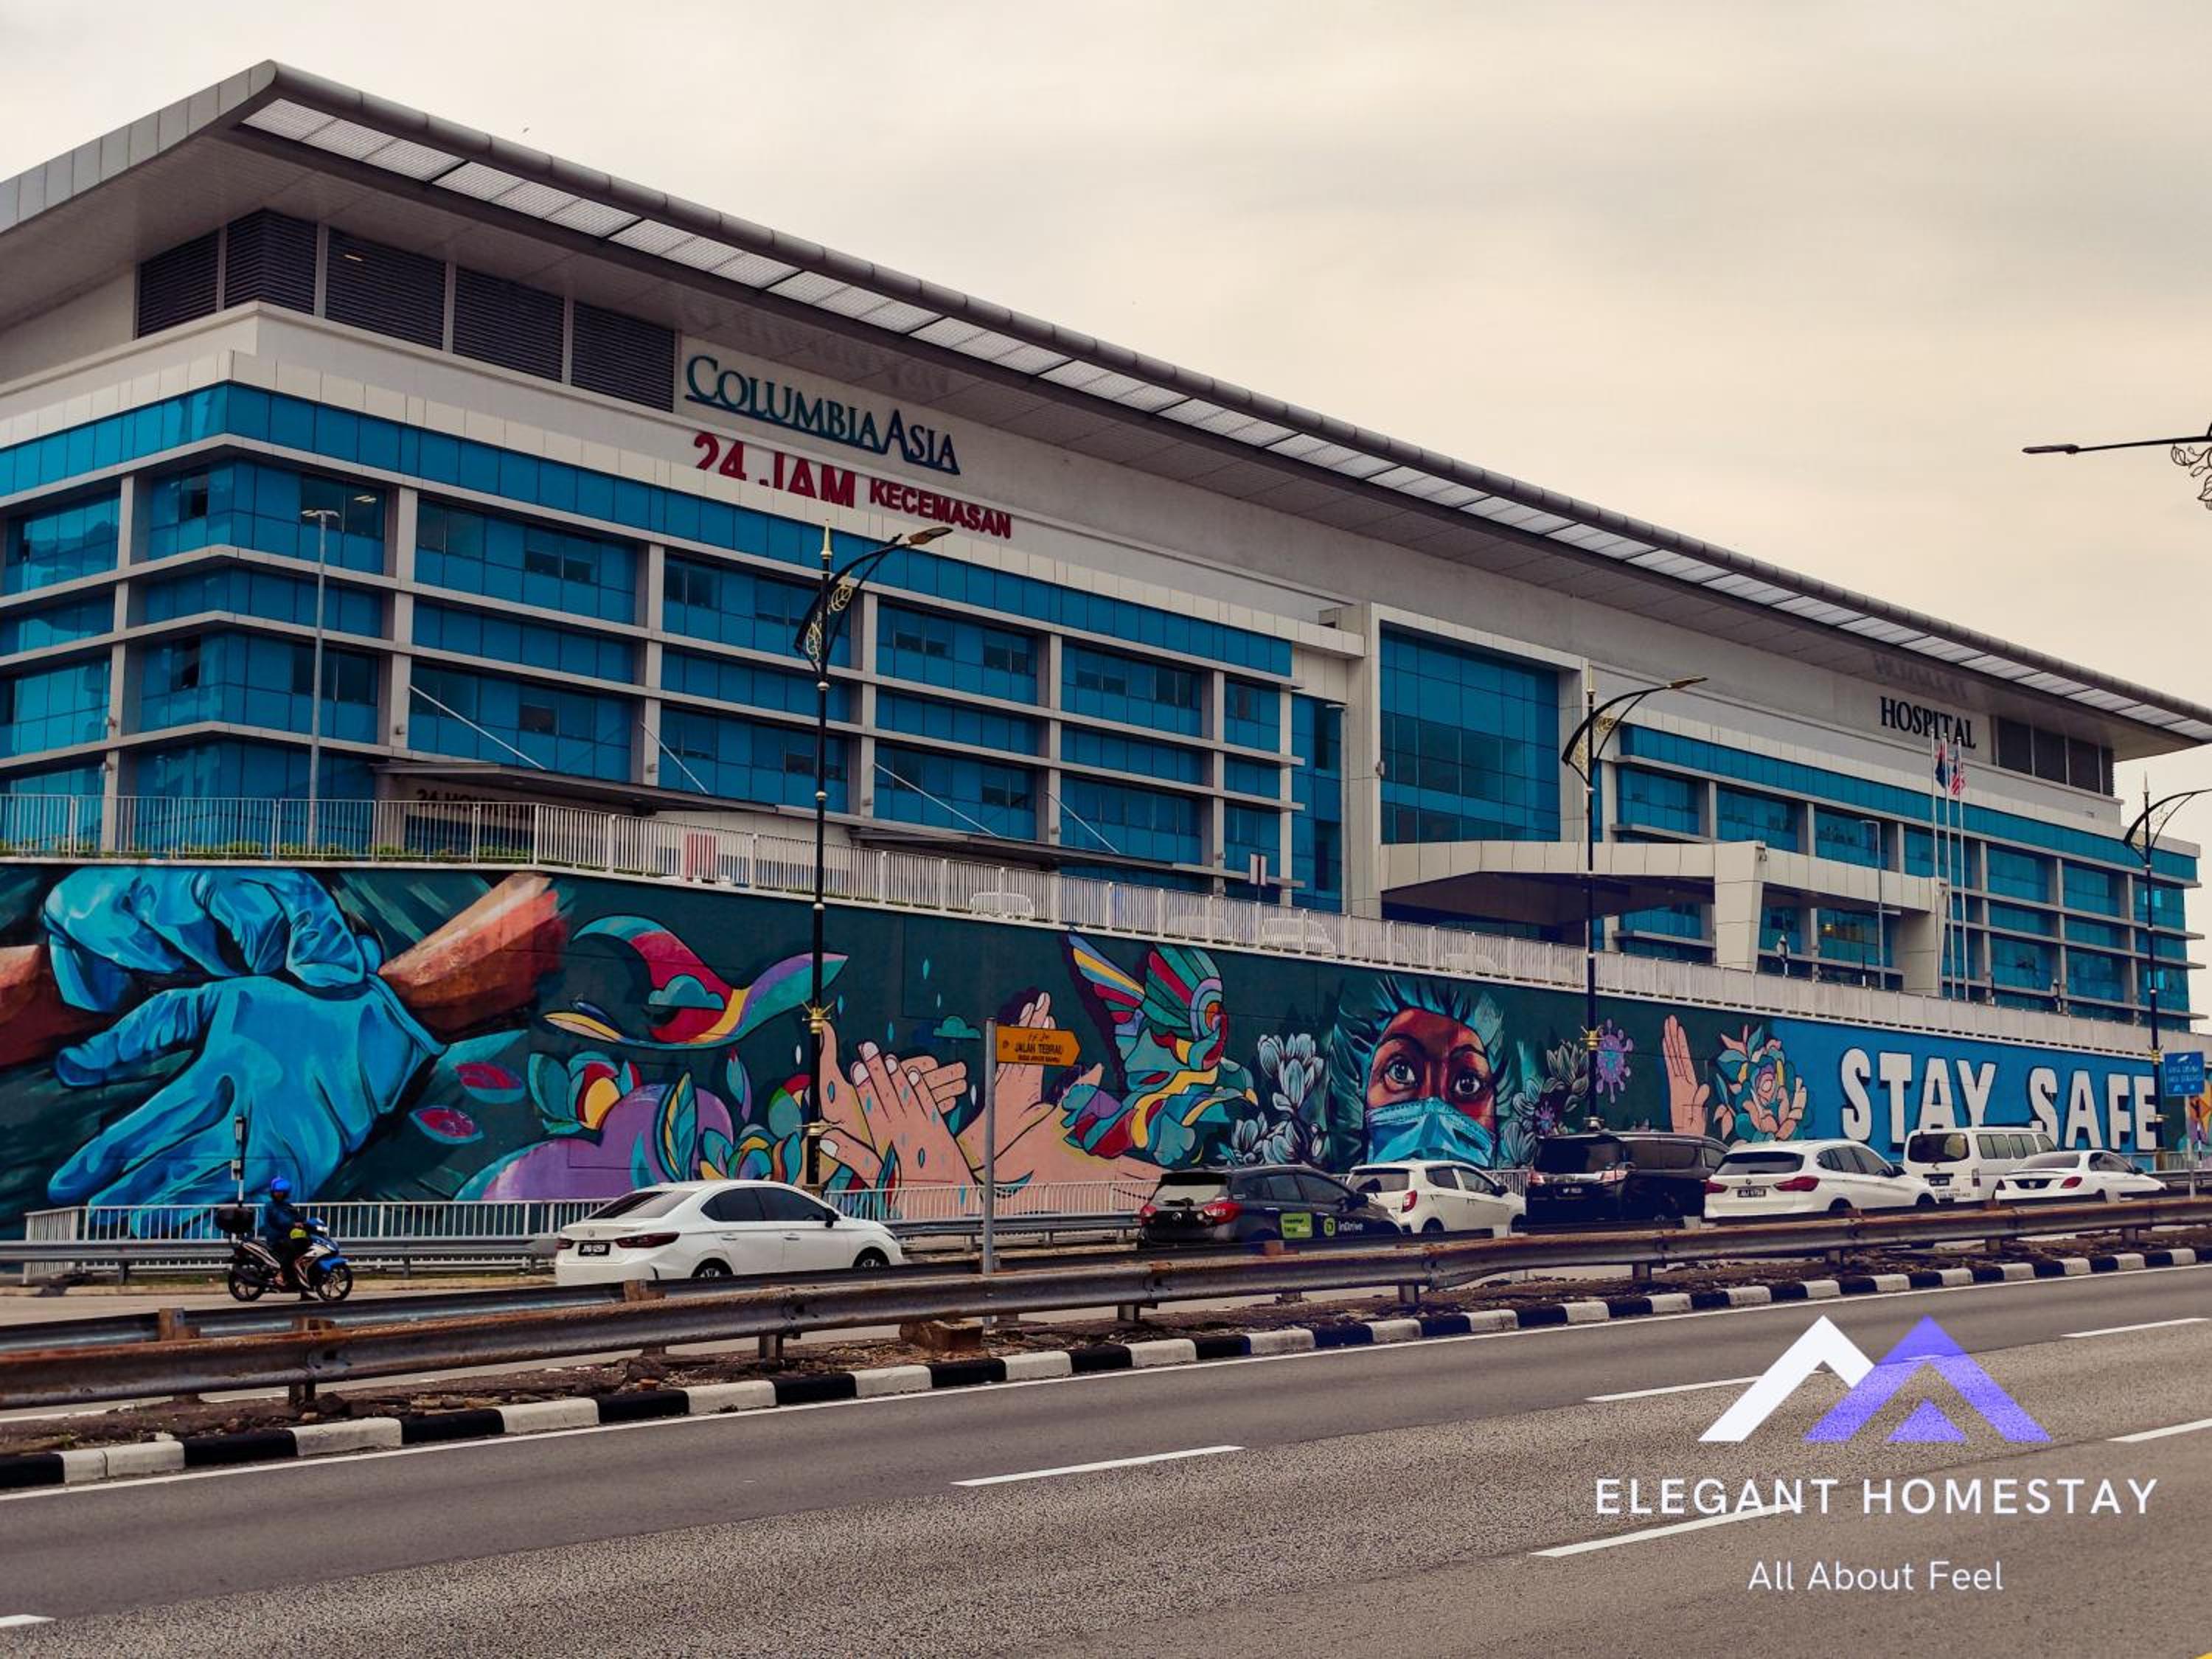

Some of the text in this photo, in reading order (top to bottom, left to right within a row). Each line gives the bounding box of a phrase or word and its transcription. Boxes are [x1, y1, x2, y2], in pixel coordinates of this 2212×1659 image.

[693, 431, 747, 481] 24
[869, 478, 1012, 539] KECEMASAN
[1880, 696, 1976, 749] HOSPITAL
[1015, 1043, 1036, 1053] JALAN
[1840, 1048, 2157, 1151] STAY SAFE
